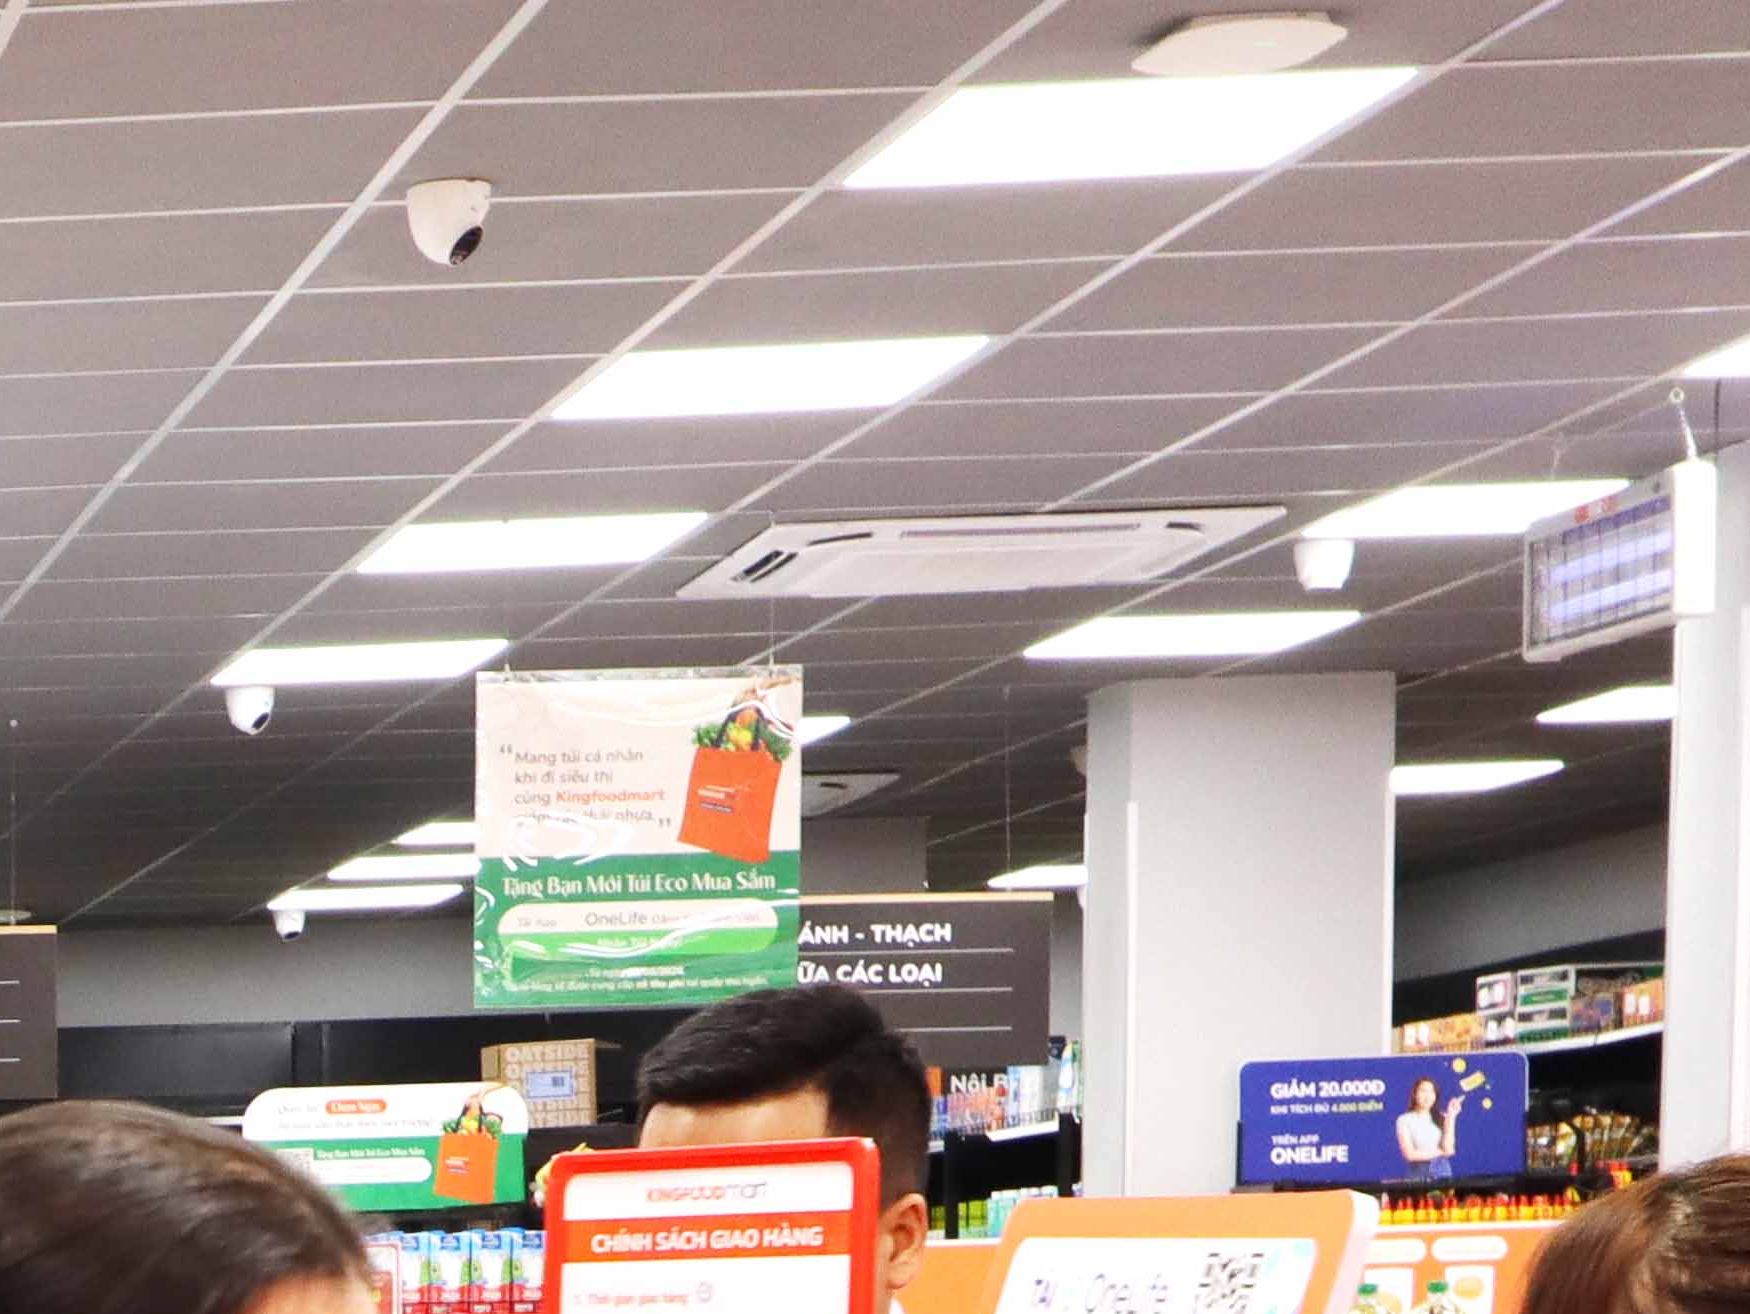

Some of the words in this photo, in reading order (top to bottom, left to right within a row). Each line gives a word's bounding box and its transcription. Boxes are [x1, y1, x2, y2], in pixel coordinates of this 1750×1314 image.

[555, 788, 666, 804] Kingfoodmart
[502, 876, 544, 898] Tặng
[546, 876, 582, 897] Bạn
[586, 873, 622, 894] Mới
[625, 872, 651, 894] Túi
[654, 874, 688, 893] Eco
[692, 872, 733, 891] Mua
[736, 867, 776, 890] Sắm
[797, 921, 850, 944] ÁNH
[870, 922, 952, 948] THẠCH
[797, 961, 830, 984] ỮA
[836, 959, 885, 983] CÁC
[888, 962, 943, 987] LOẠI
[1270, 1078, 1317, 1100] GIẢM
[1270, 1144, 1350, 1165] ONELIFE
[591, 1227, 652, 1253] CHÍNH
[655, 1224, 704, 1251] SÁCH
[709, 1227, 760, 1250] GIAO
[762, 1222, 825, 1248] HÀNG
